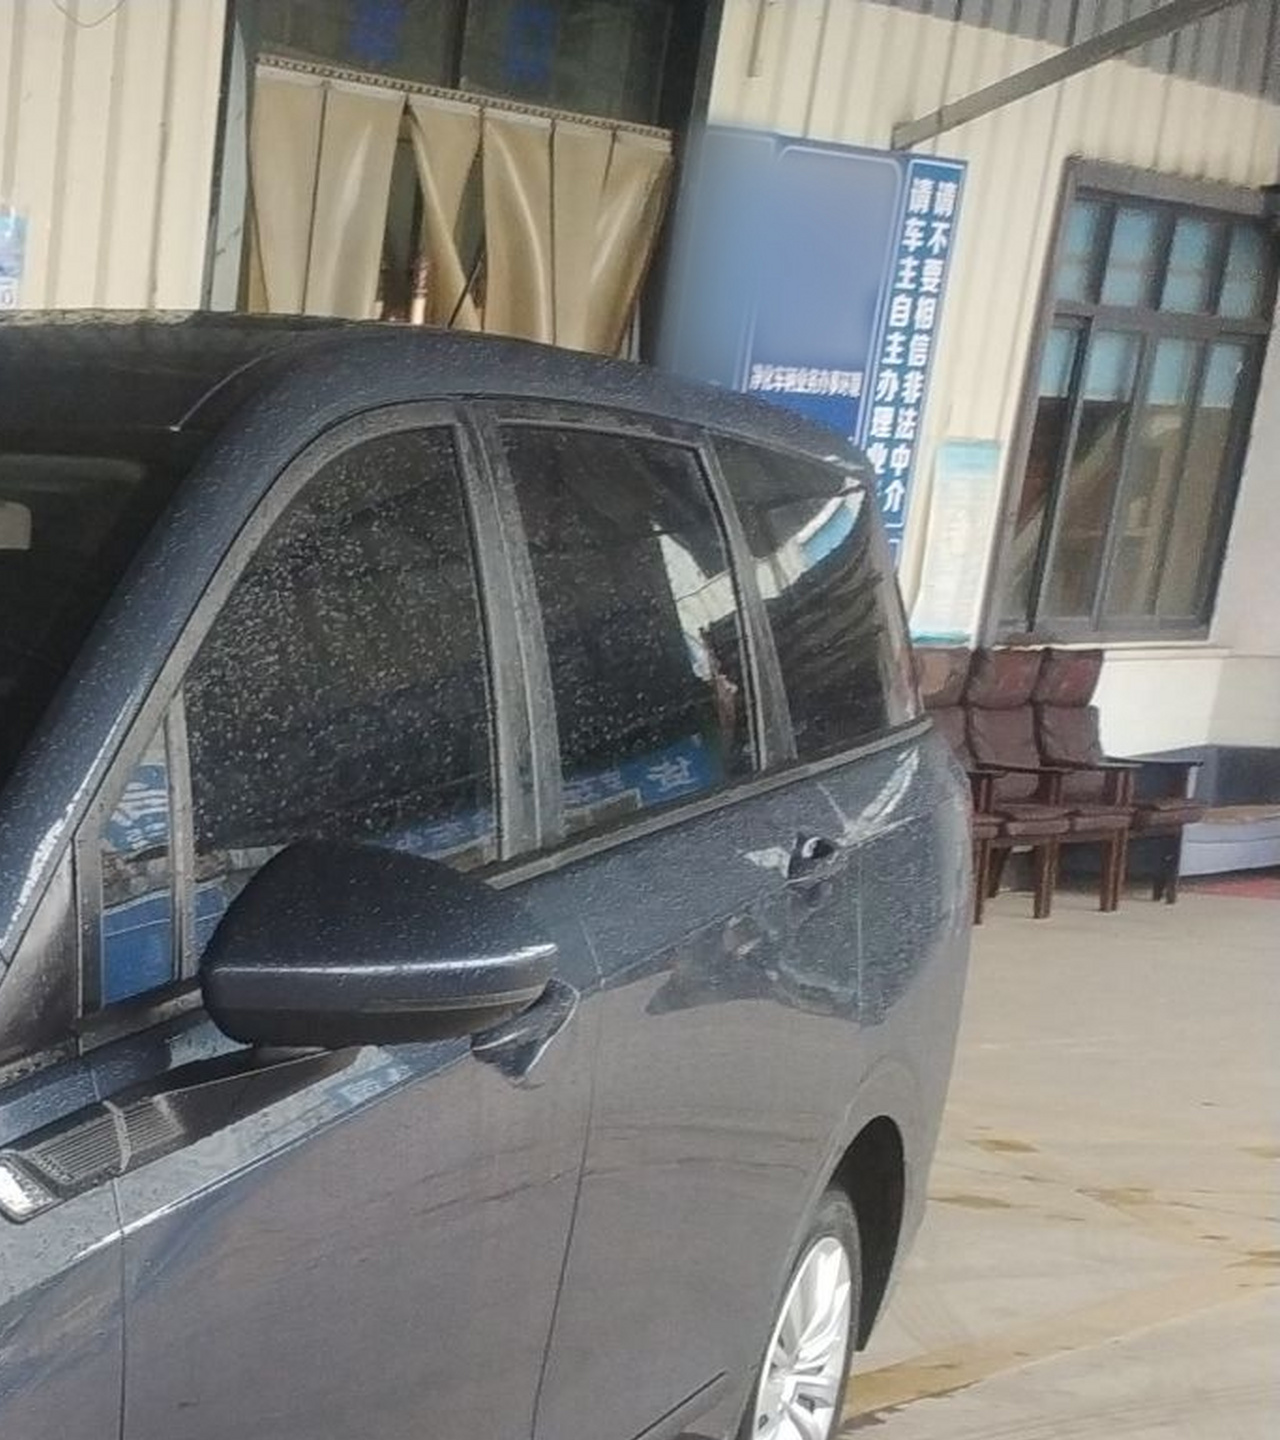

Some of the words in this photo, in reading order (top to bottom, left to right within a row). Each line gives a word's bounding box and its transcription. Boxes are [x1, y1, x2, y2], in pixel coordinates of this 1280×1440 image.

[867, 178, 935, 495] 请车主自主办理业
[883, 180, 958, 512] 请不要相信非法中介
